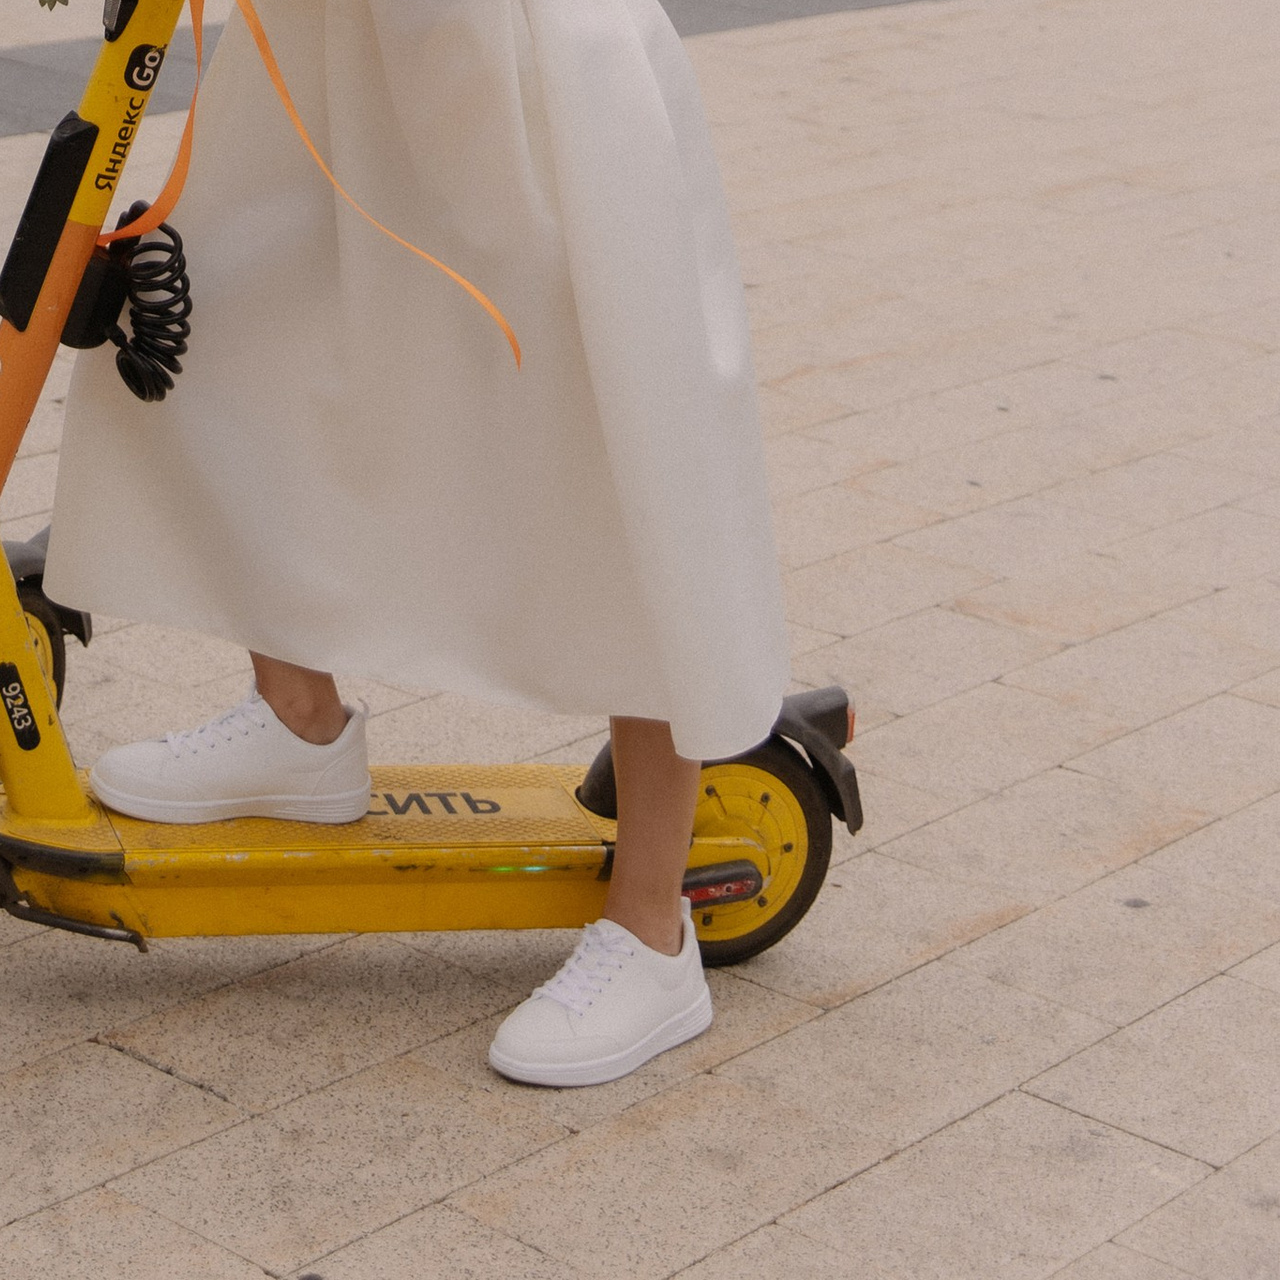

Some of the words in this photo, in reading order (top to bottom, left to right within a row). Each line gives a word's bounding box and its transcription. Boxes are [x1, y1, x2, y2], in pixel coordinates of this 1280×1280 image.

[94, 97, 145, 191] Яндекс
[132, 50, 161, 87] Go
[2, 682, 32, 730] 9243
